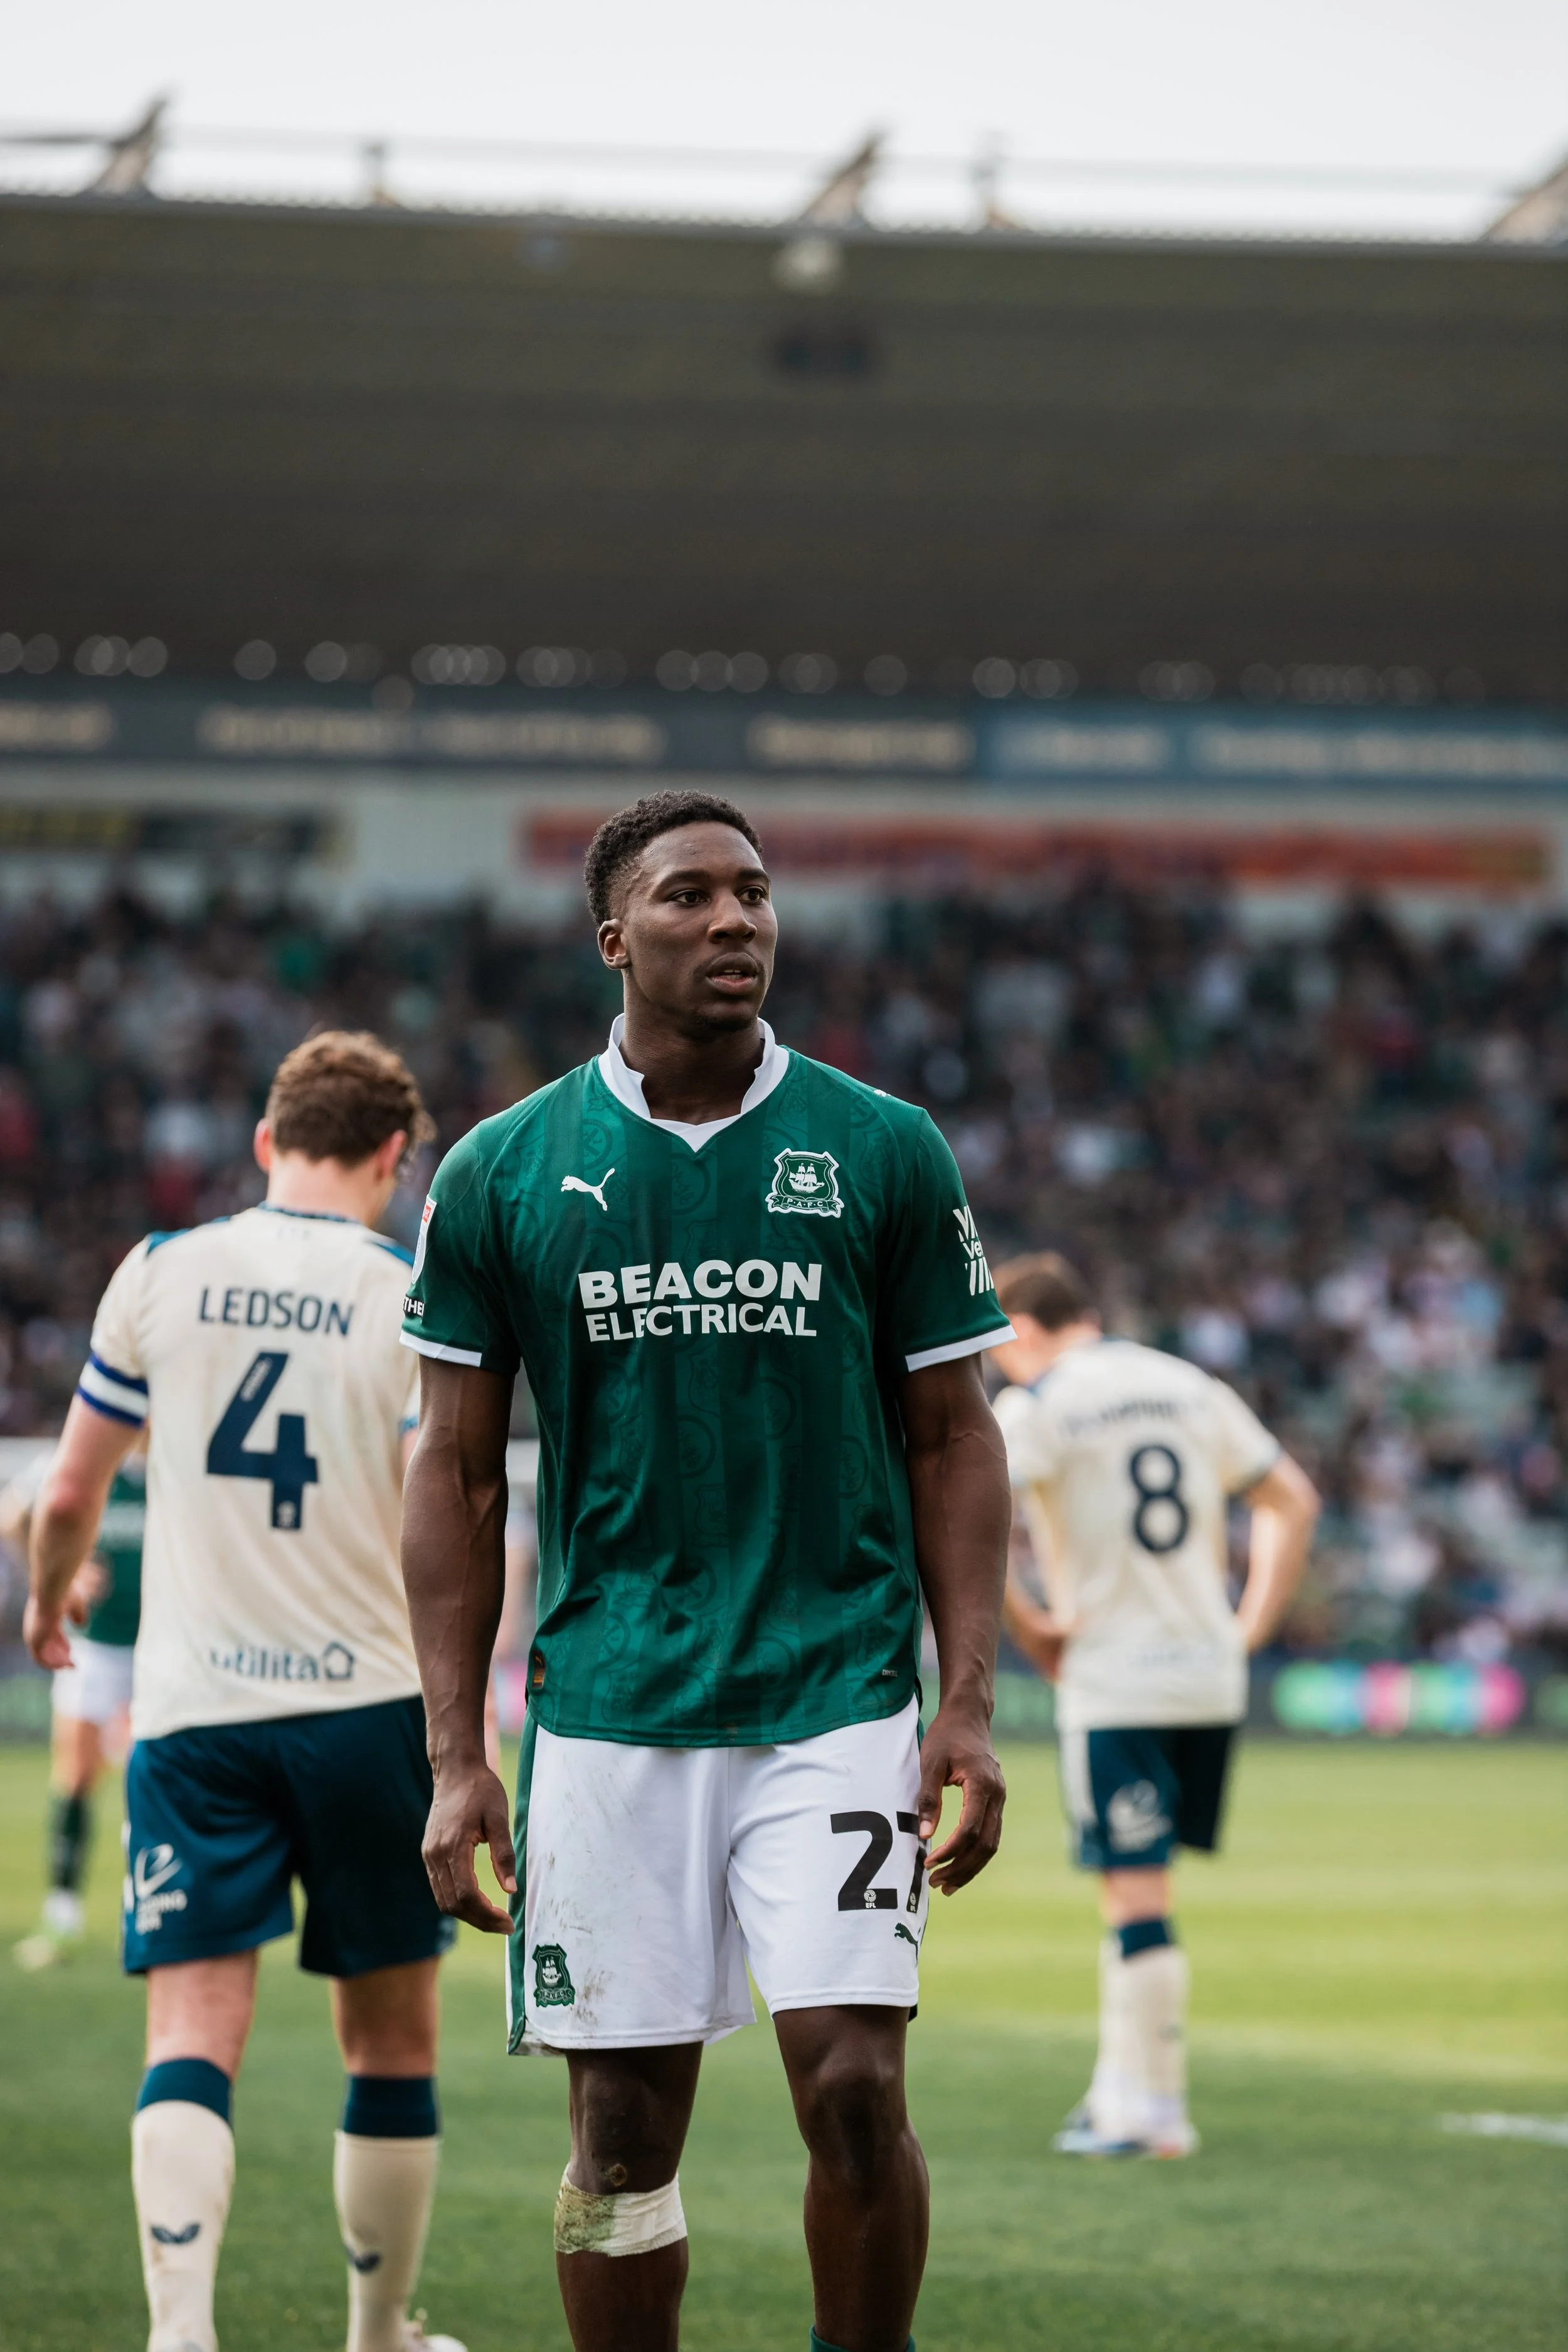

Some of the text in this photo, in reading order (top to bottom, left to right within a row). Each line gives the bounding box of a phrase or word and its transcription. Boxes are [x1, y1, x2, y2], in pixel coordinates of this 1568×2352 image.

[578, 1259, 822, 1309] BEACON
[199, 1287, 354, 1337] LEDSON
[586, 1303, 817, 1342] ELECTRICAL
[206, 1352, 319, 1530] 4
[1129, 1444, 1190, 1555] 8
[210, 1646, 319, 1680] utilita
[830, 1811, 927, 1914] 27
